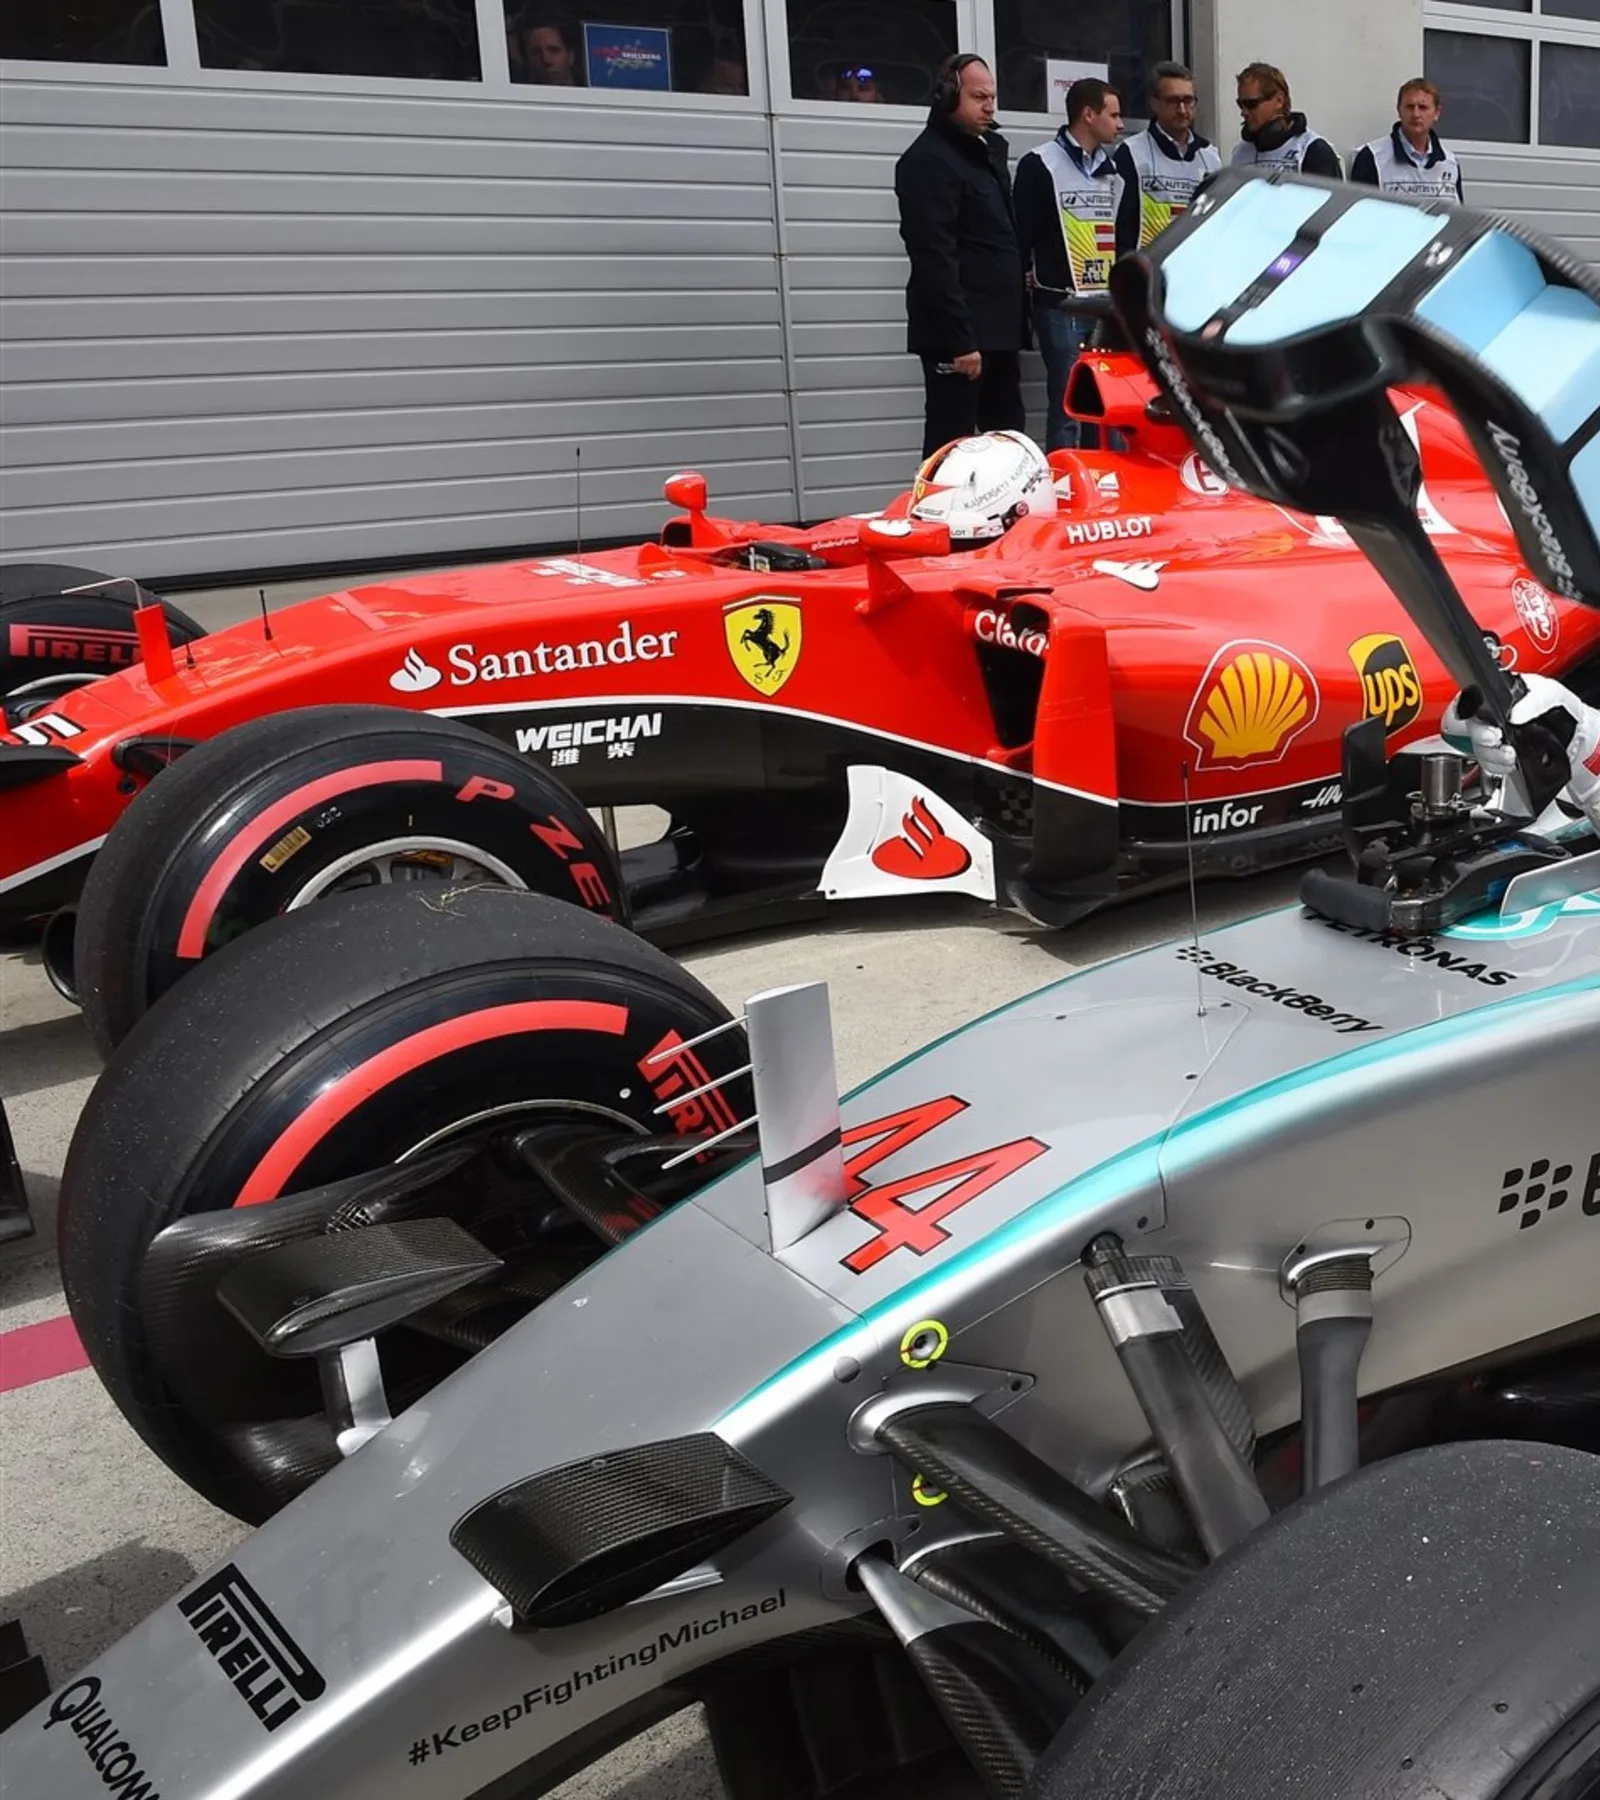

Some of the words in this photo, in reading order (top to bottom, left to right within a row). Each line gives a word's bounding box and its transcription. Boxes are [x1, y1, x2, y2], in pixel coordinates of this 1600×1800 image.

[1066, 517, 1153, 545] HUBLOT
[1486, 419, 1574, 579] BlackBerry
[448, 620, 677, 685] Santander
[1365, 664, 1419, 727] ups
[515, 712, 662, 753] WEICHAI
[1193, 803, 1264, 834] infor
[1200, 961, 1384, 1034] BlackBerry
[839, 1094, 1053, 1276] 44
[177, 1562, 327, 1733] PIRELLI
[407, 1588, 787, 1767] #KeepFightingMichael
